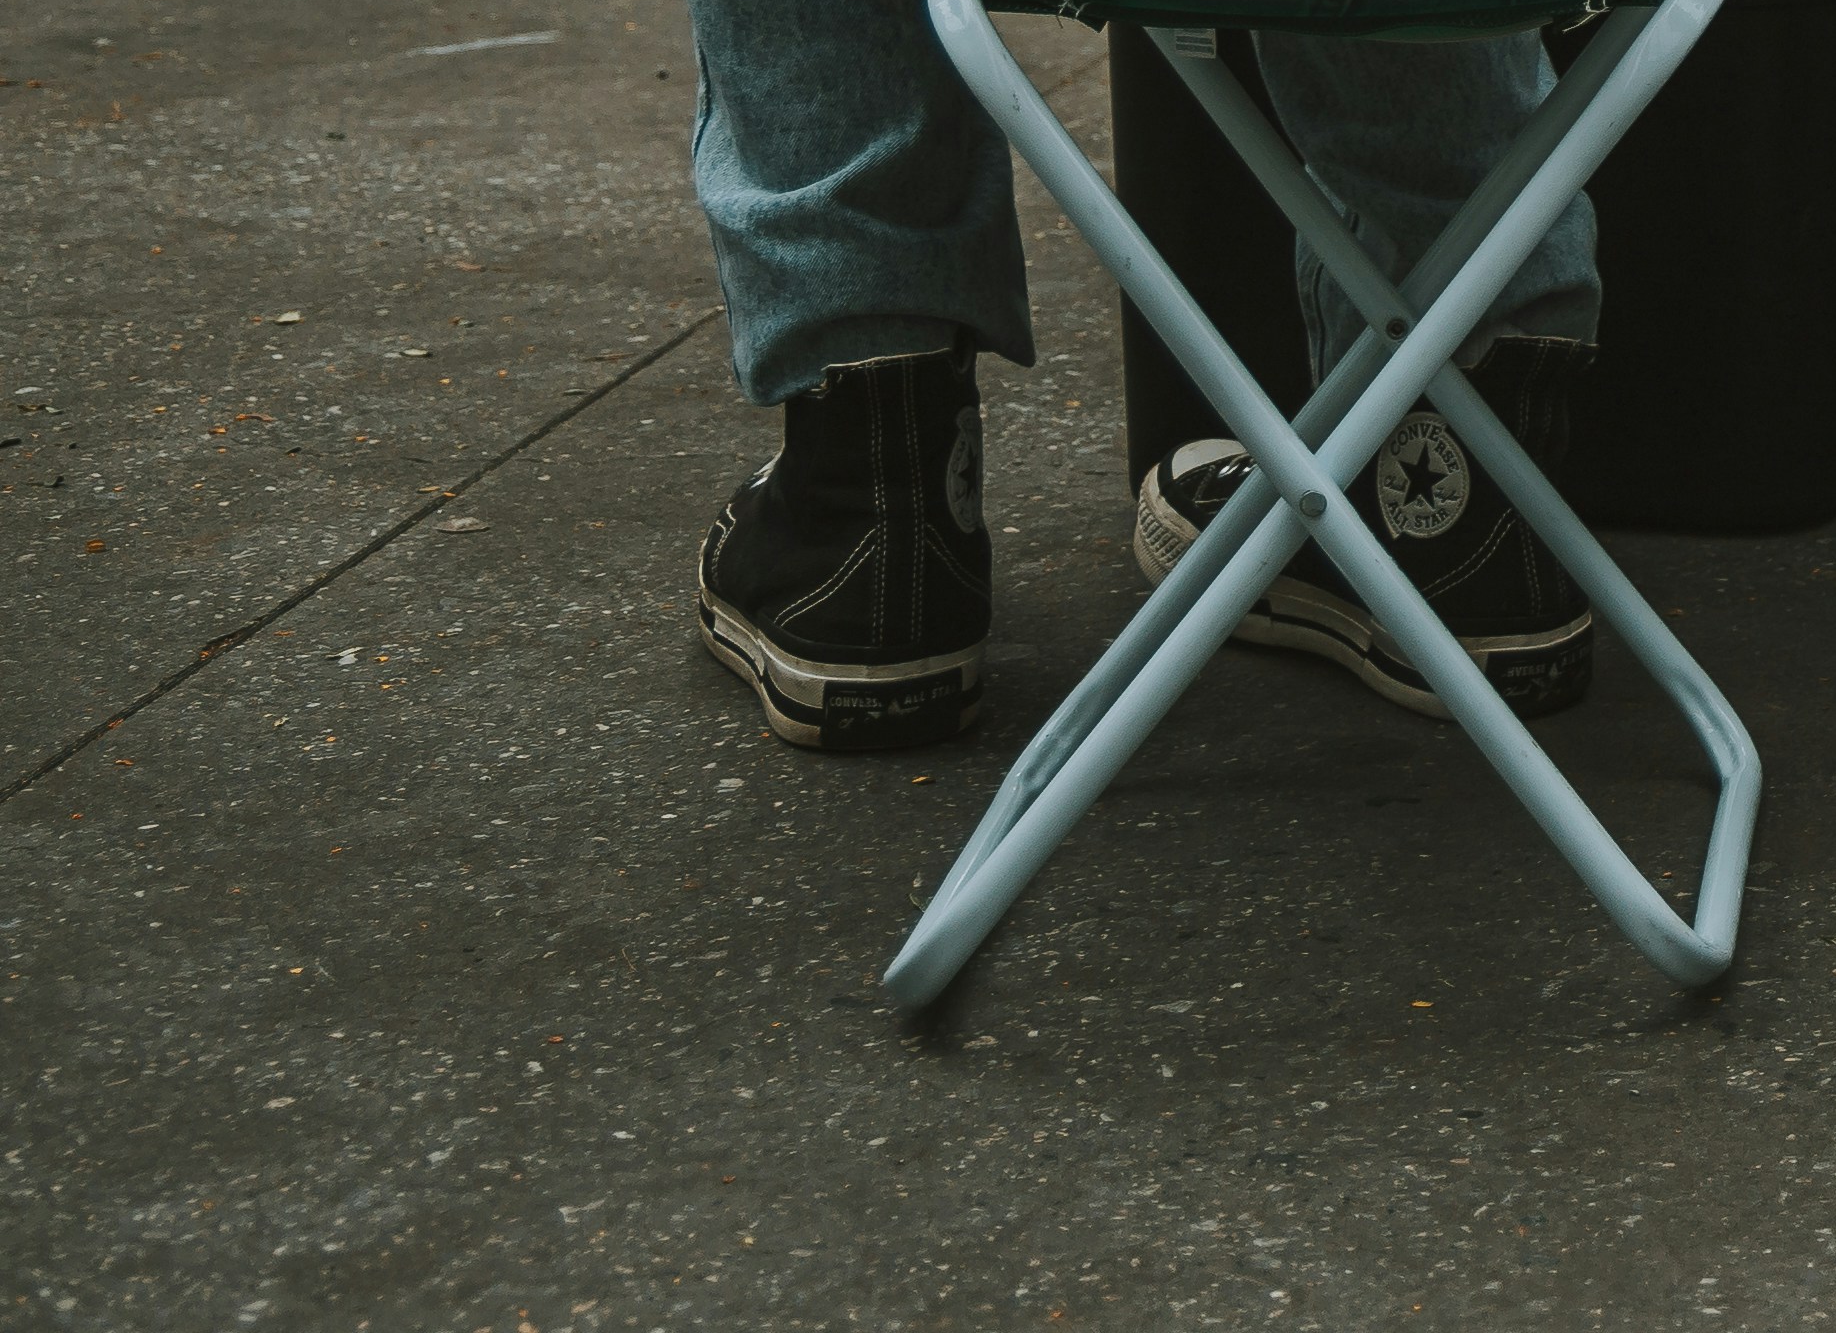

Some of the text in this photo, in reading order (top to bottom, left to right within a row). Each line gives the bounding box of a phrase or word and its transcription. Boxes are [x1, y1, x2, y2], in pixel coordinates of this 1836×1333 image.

[1390, 421, 1460, 475] CONVERSE
[1386, 501, 1450, 530] ALL STAR
